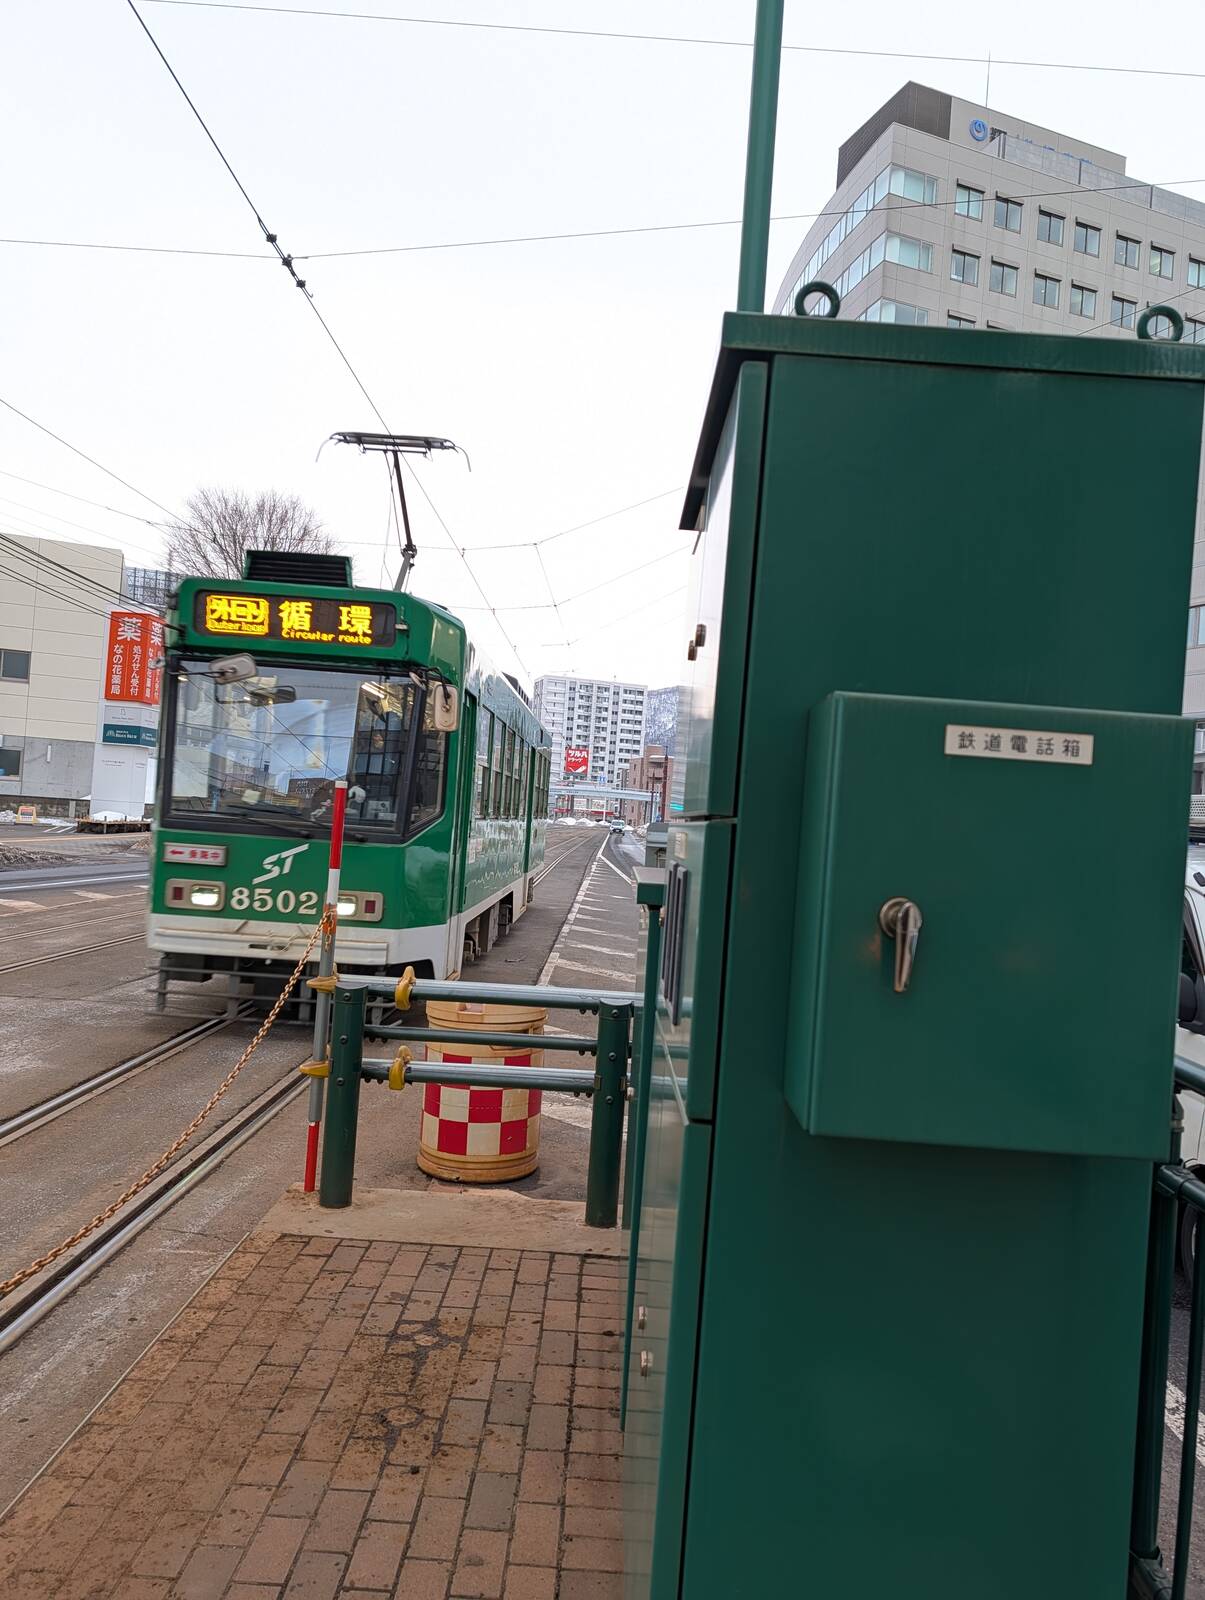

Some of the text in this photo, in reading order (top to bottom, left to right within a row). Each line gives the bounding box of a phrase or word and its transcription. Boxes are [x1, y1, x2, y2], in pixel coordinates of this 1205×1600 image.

[116, 617, 142, 641] 薬
[278, 600, 373, 635] 循環
[281, 628, 372, 645] Circular route
[110, 644, 124, 695] なの花薬局
[130, 645, 142, 696] 処方せん受付
[568, 749, 588, 758] ツルハ
[957, 731, 1081, 758] 鉄道電話箱
[252, 843, 310, 885] ST
[230, 887, 318, 915] 8502
